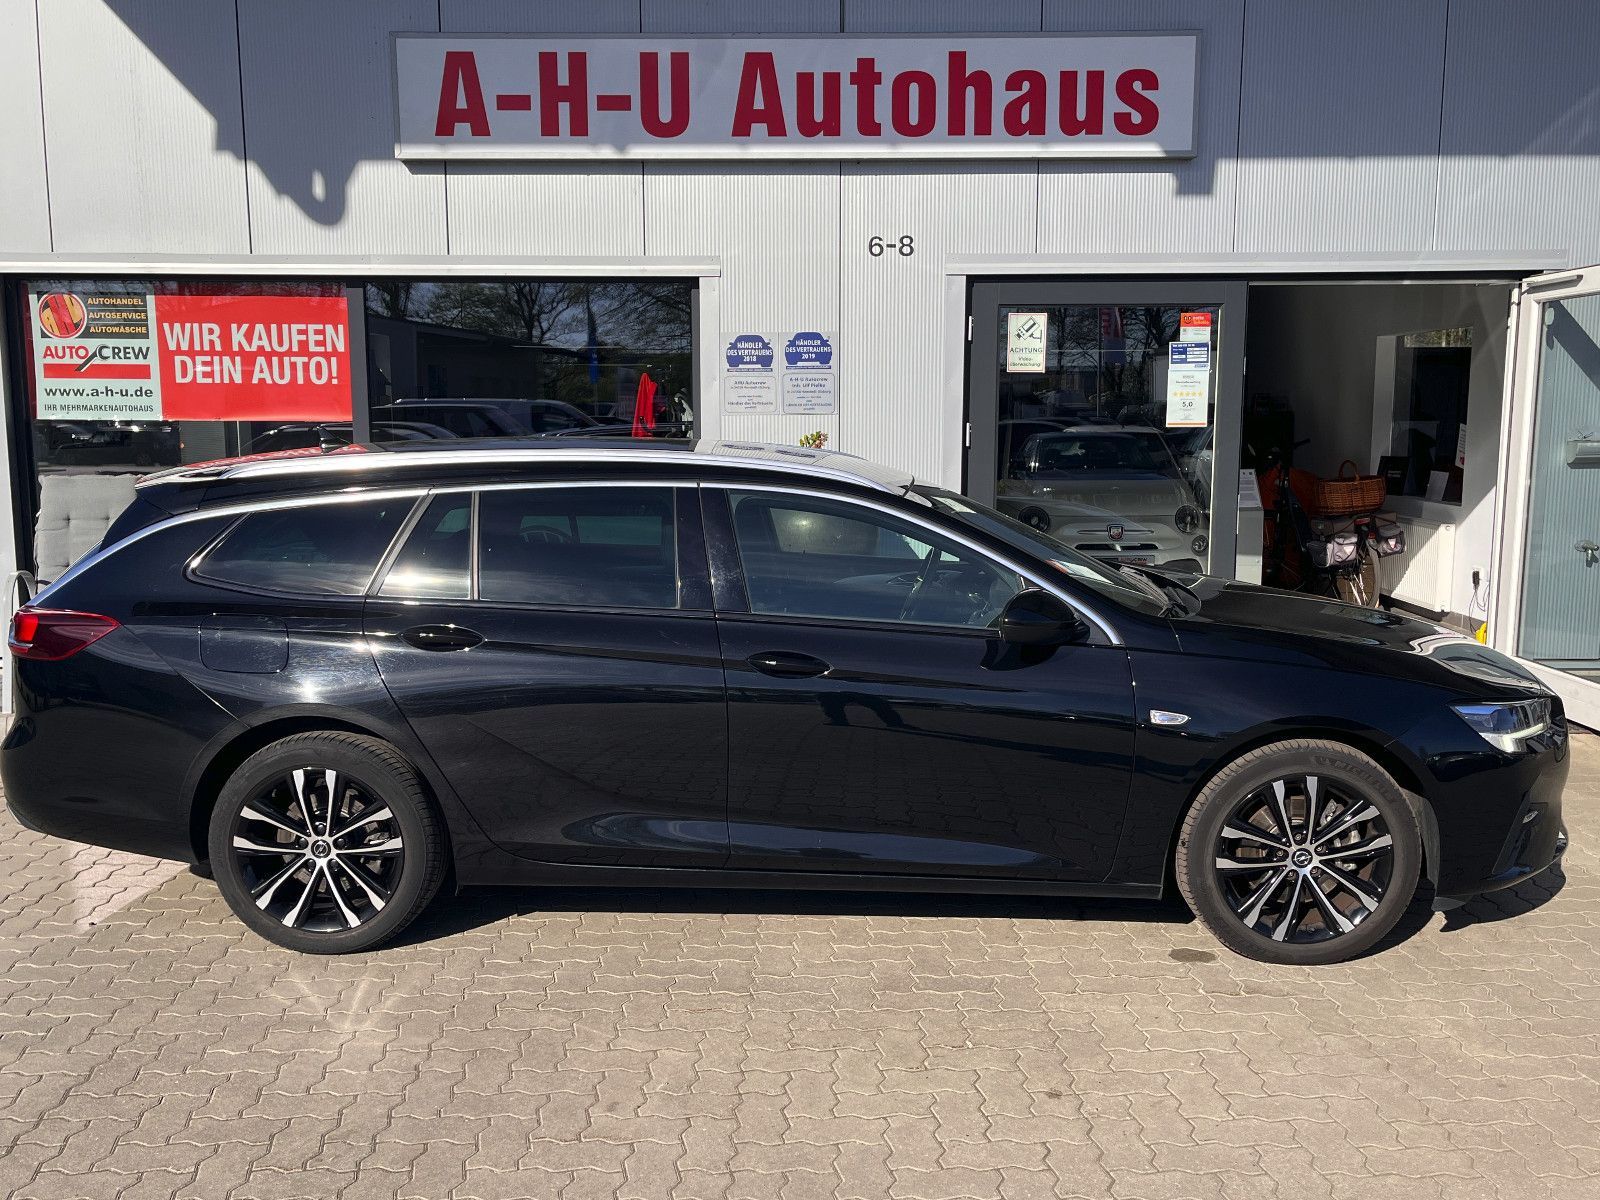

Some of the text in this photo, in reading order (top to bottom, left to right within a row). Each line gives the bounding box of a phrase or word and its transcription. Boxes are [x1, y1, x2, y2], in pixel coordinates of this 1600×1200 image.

[435, 51, 1160, 138] A-H-U Autohaus
[868, 235, 915, 257] 6-8
[87, 297, 144, 305] AUTOHANDEL
[90, 324, 148, 333] AUTOWÄSCHE
[163, 322, 345, 352] WIR KAUFEN
[174, 355, 338, 384] DEIN AUTO!
[44, 386, 154, 398] www.a-h-u.de
[44, 403, 154, 412] IHR MEHRMARKENAUTOHAUS
